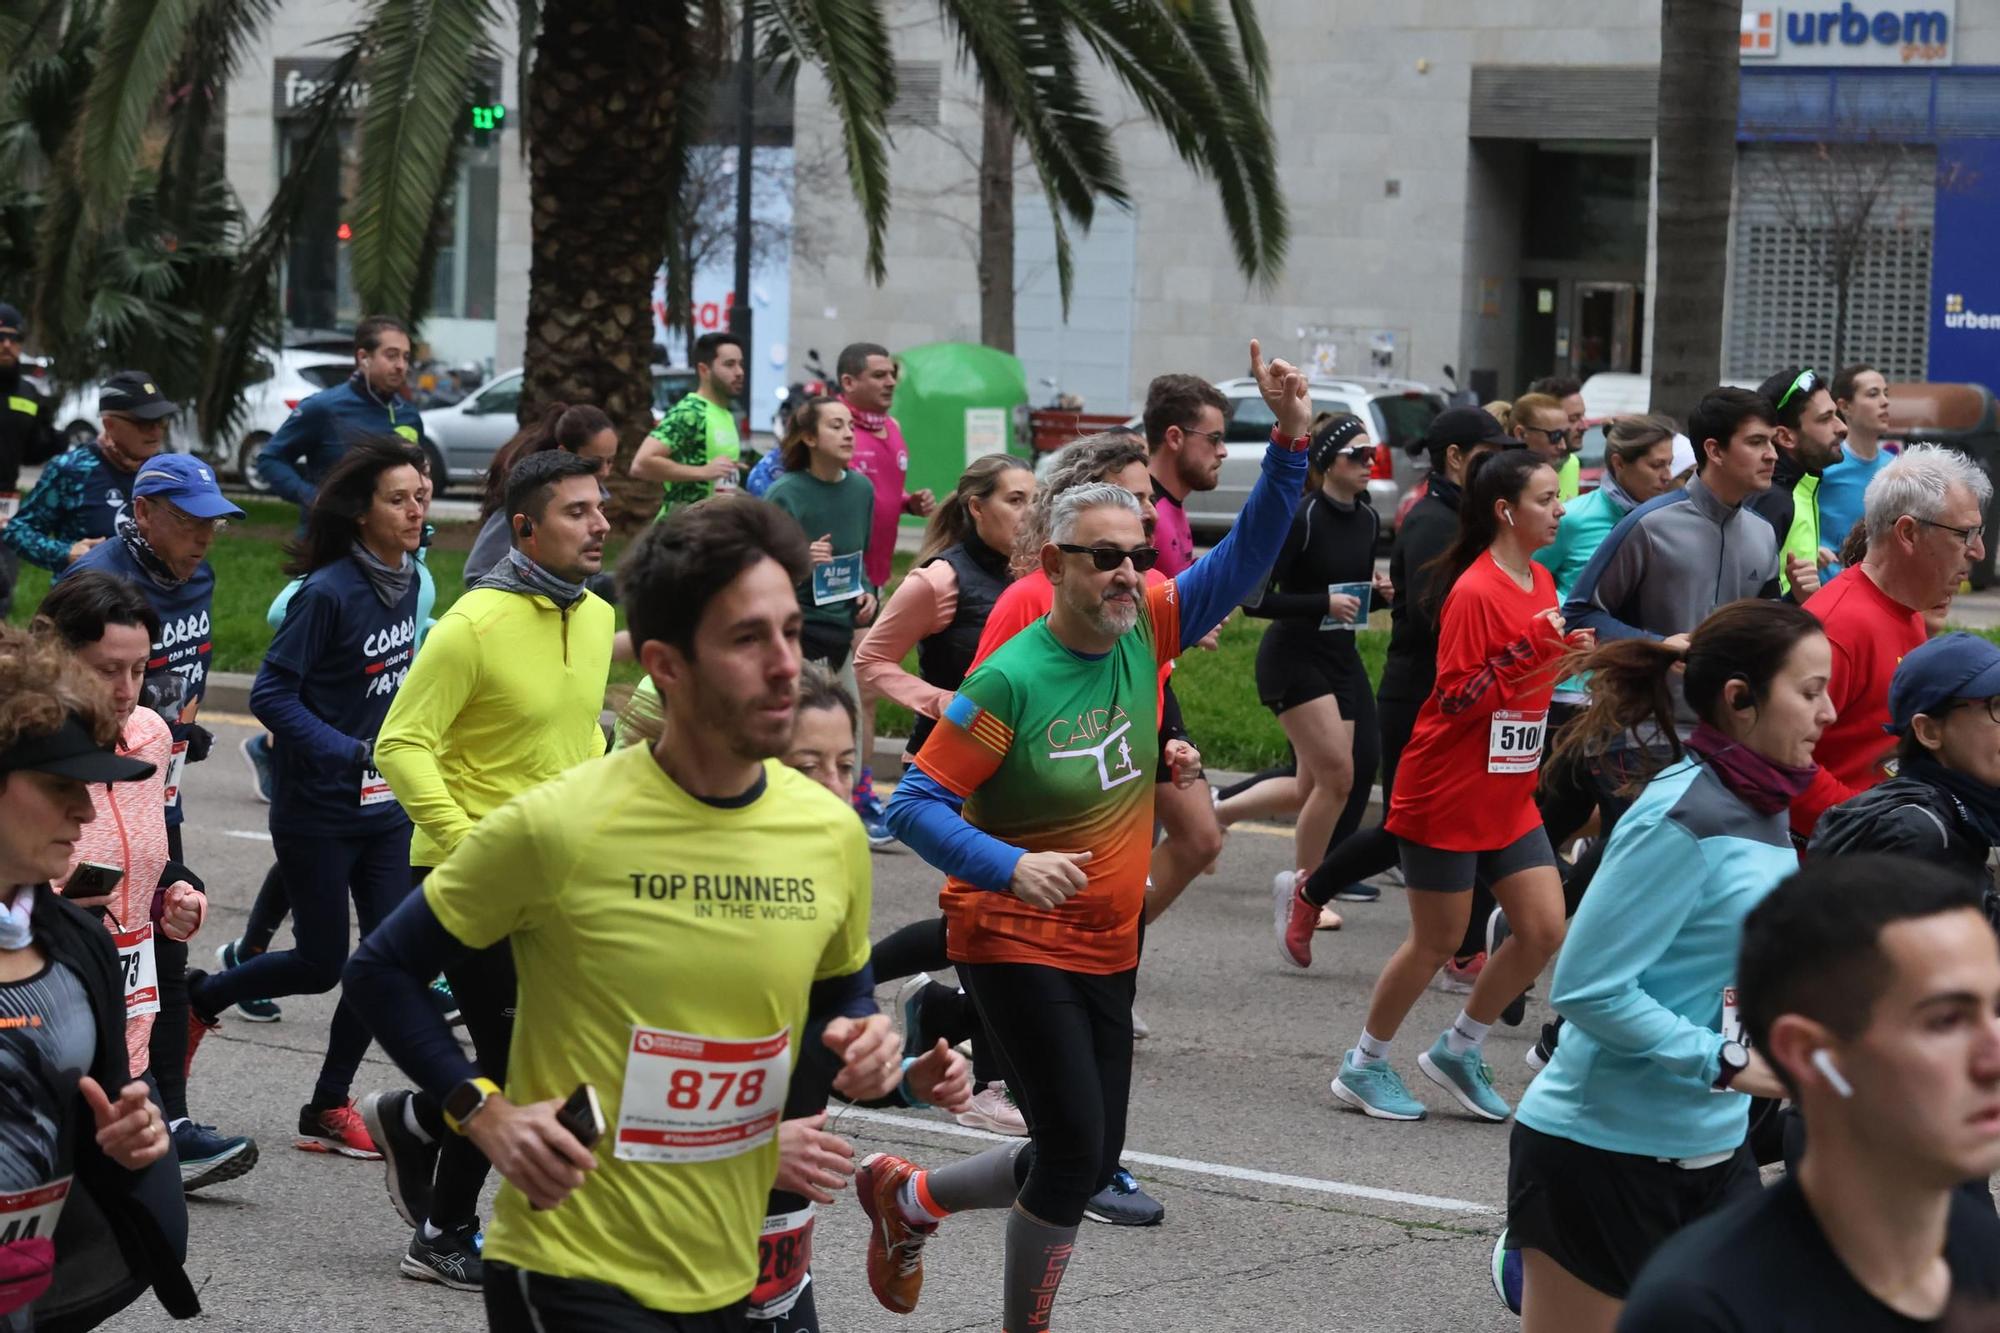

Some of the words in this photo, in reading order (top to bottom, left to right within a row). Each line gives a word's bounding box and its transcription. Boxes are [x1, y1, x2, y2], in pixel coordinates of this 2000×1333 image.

[1787, 2, 1947, 45] urbem
[152, 610, 210, 650] ORRO
[363, 615, 415, 657] CORRO
[629, 873, 687, 900] TOP
[693, 874, 816, 903] RUNNERS
[695, 903, 713, 918] IN
[719, 903, 755, 920] THE
[760, 905, 818, 921] WORLD
[667, 1068, 767, 1112] 878
[1027, 1243, 1073, 1326] kalenji
